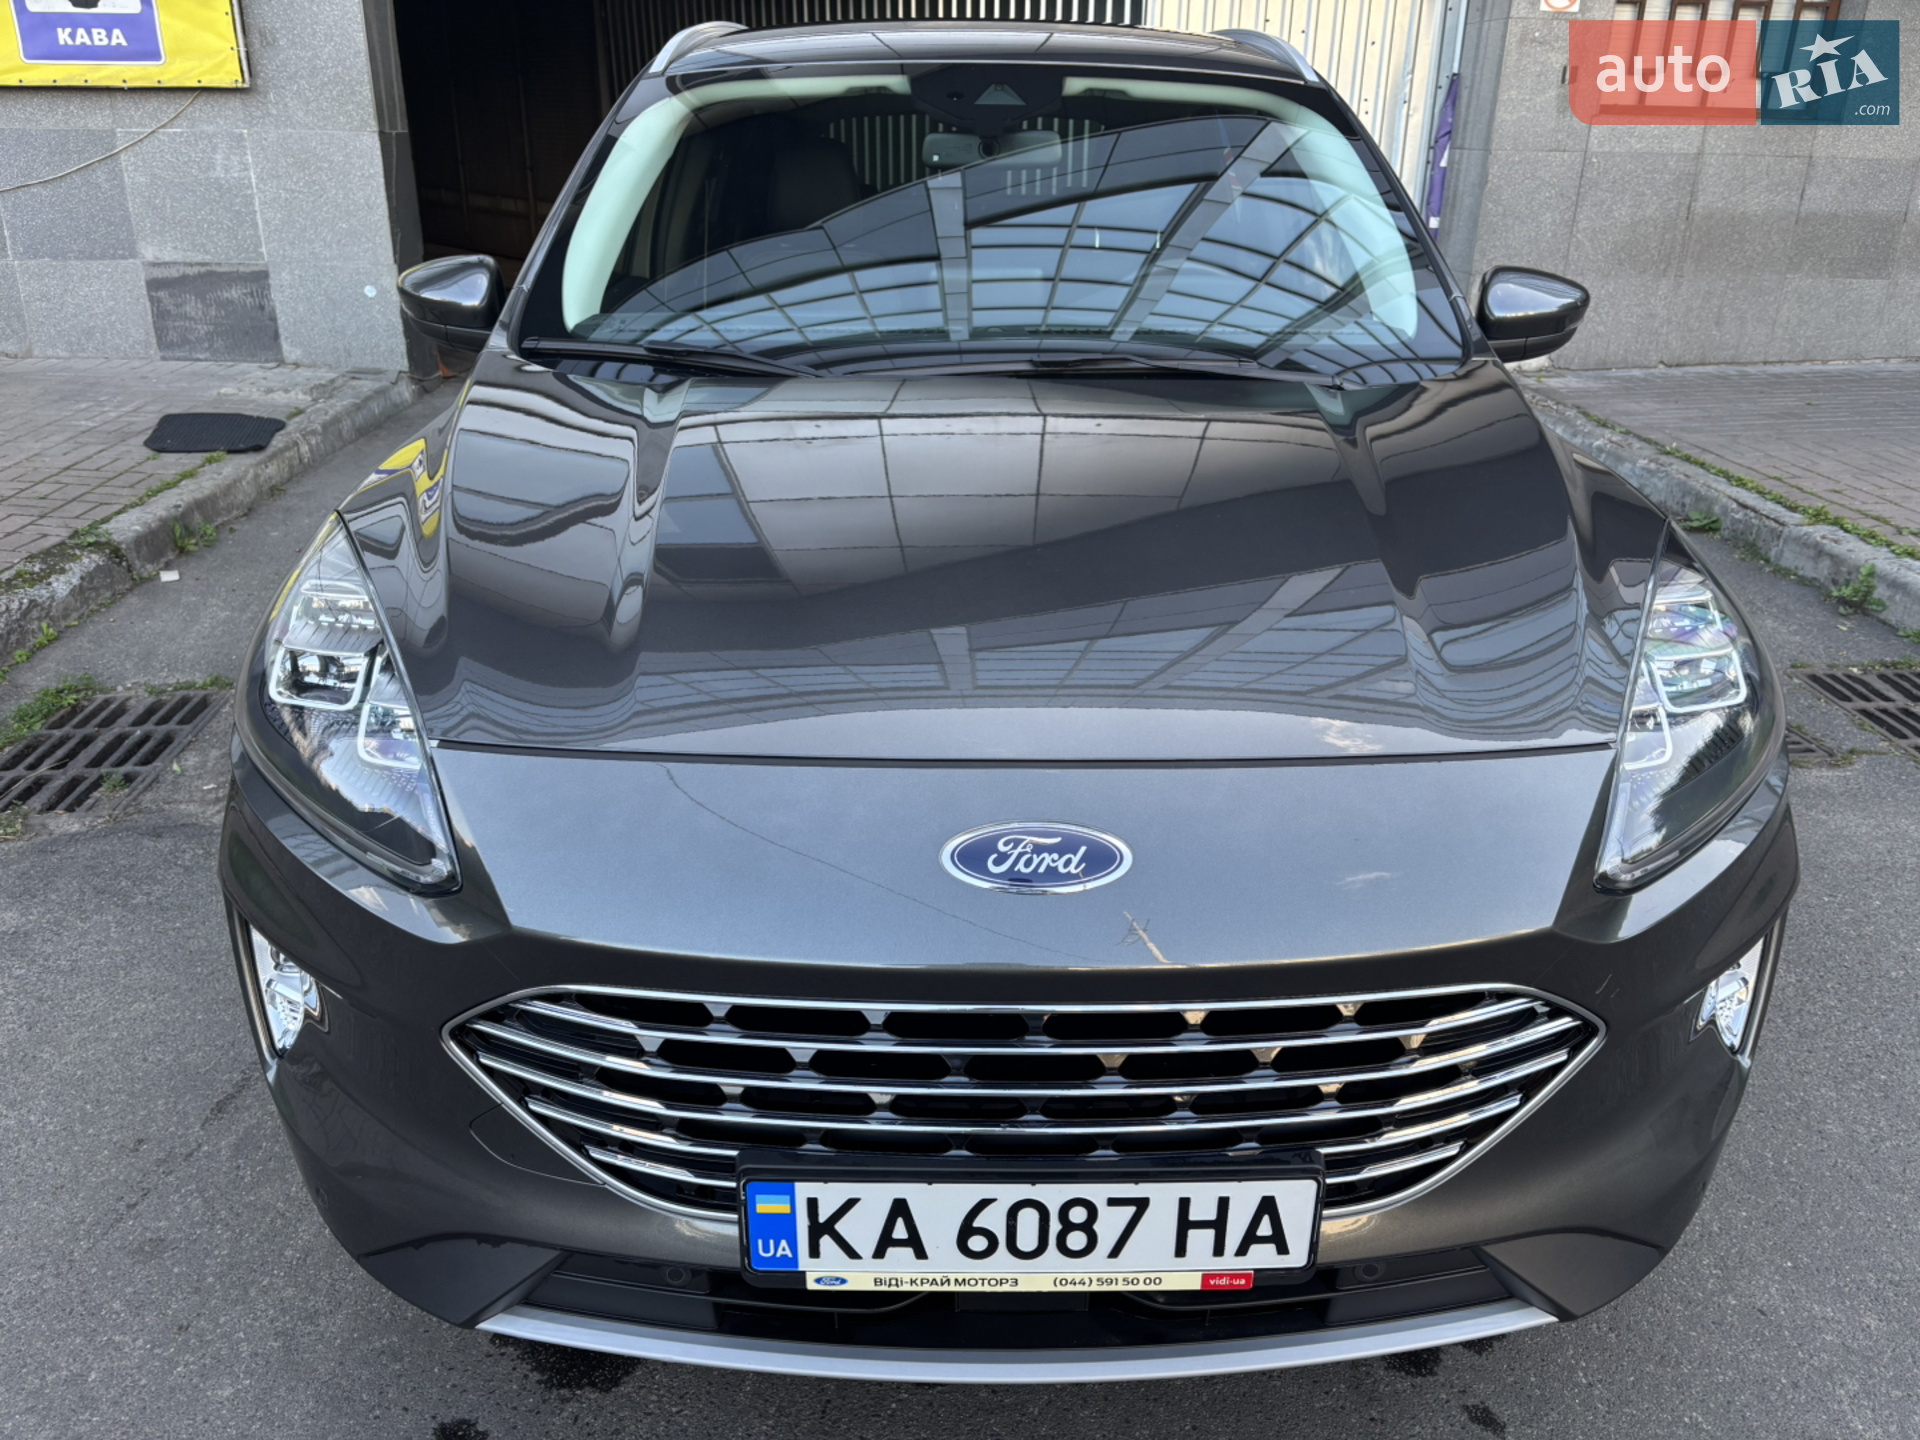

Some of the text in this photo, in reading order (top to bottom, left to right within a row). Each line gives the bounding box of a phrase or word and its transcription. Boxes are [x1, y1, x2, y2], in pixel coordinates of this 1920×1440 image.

[987, 835, 1087, 874] Ford
[956, 1196, 1150, 1260] 6087
[757, 1239, 793, 1258] UA
[1053, 1276, 1162, 1287] (044) 591 50 00
